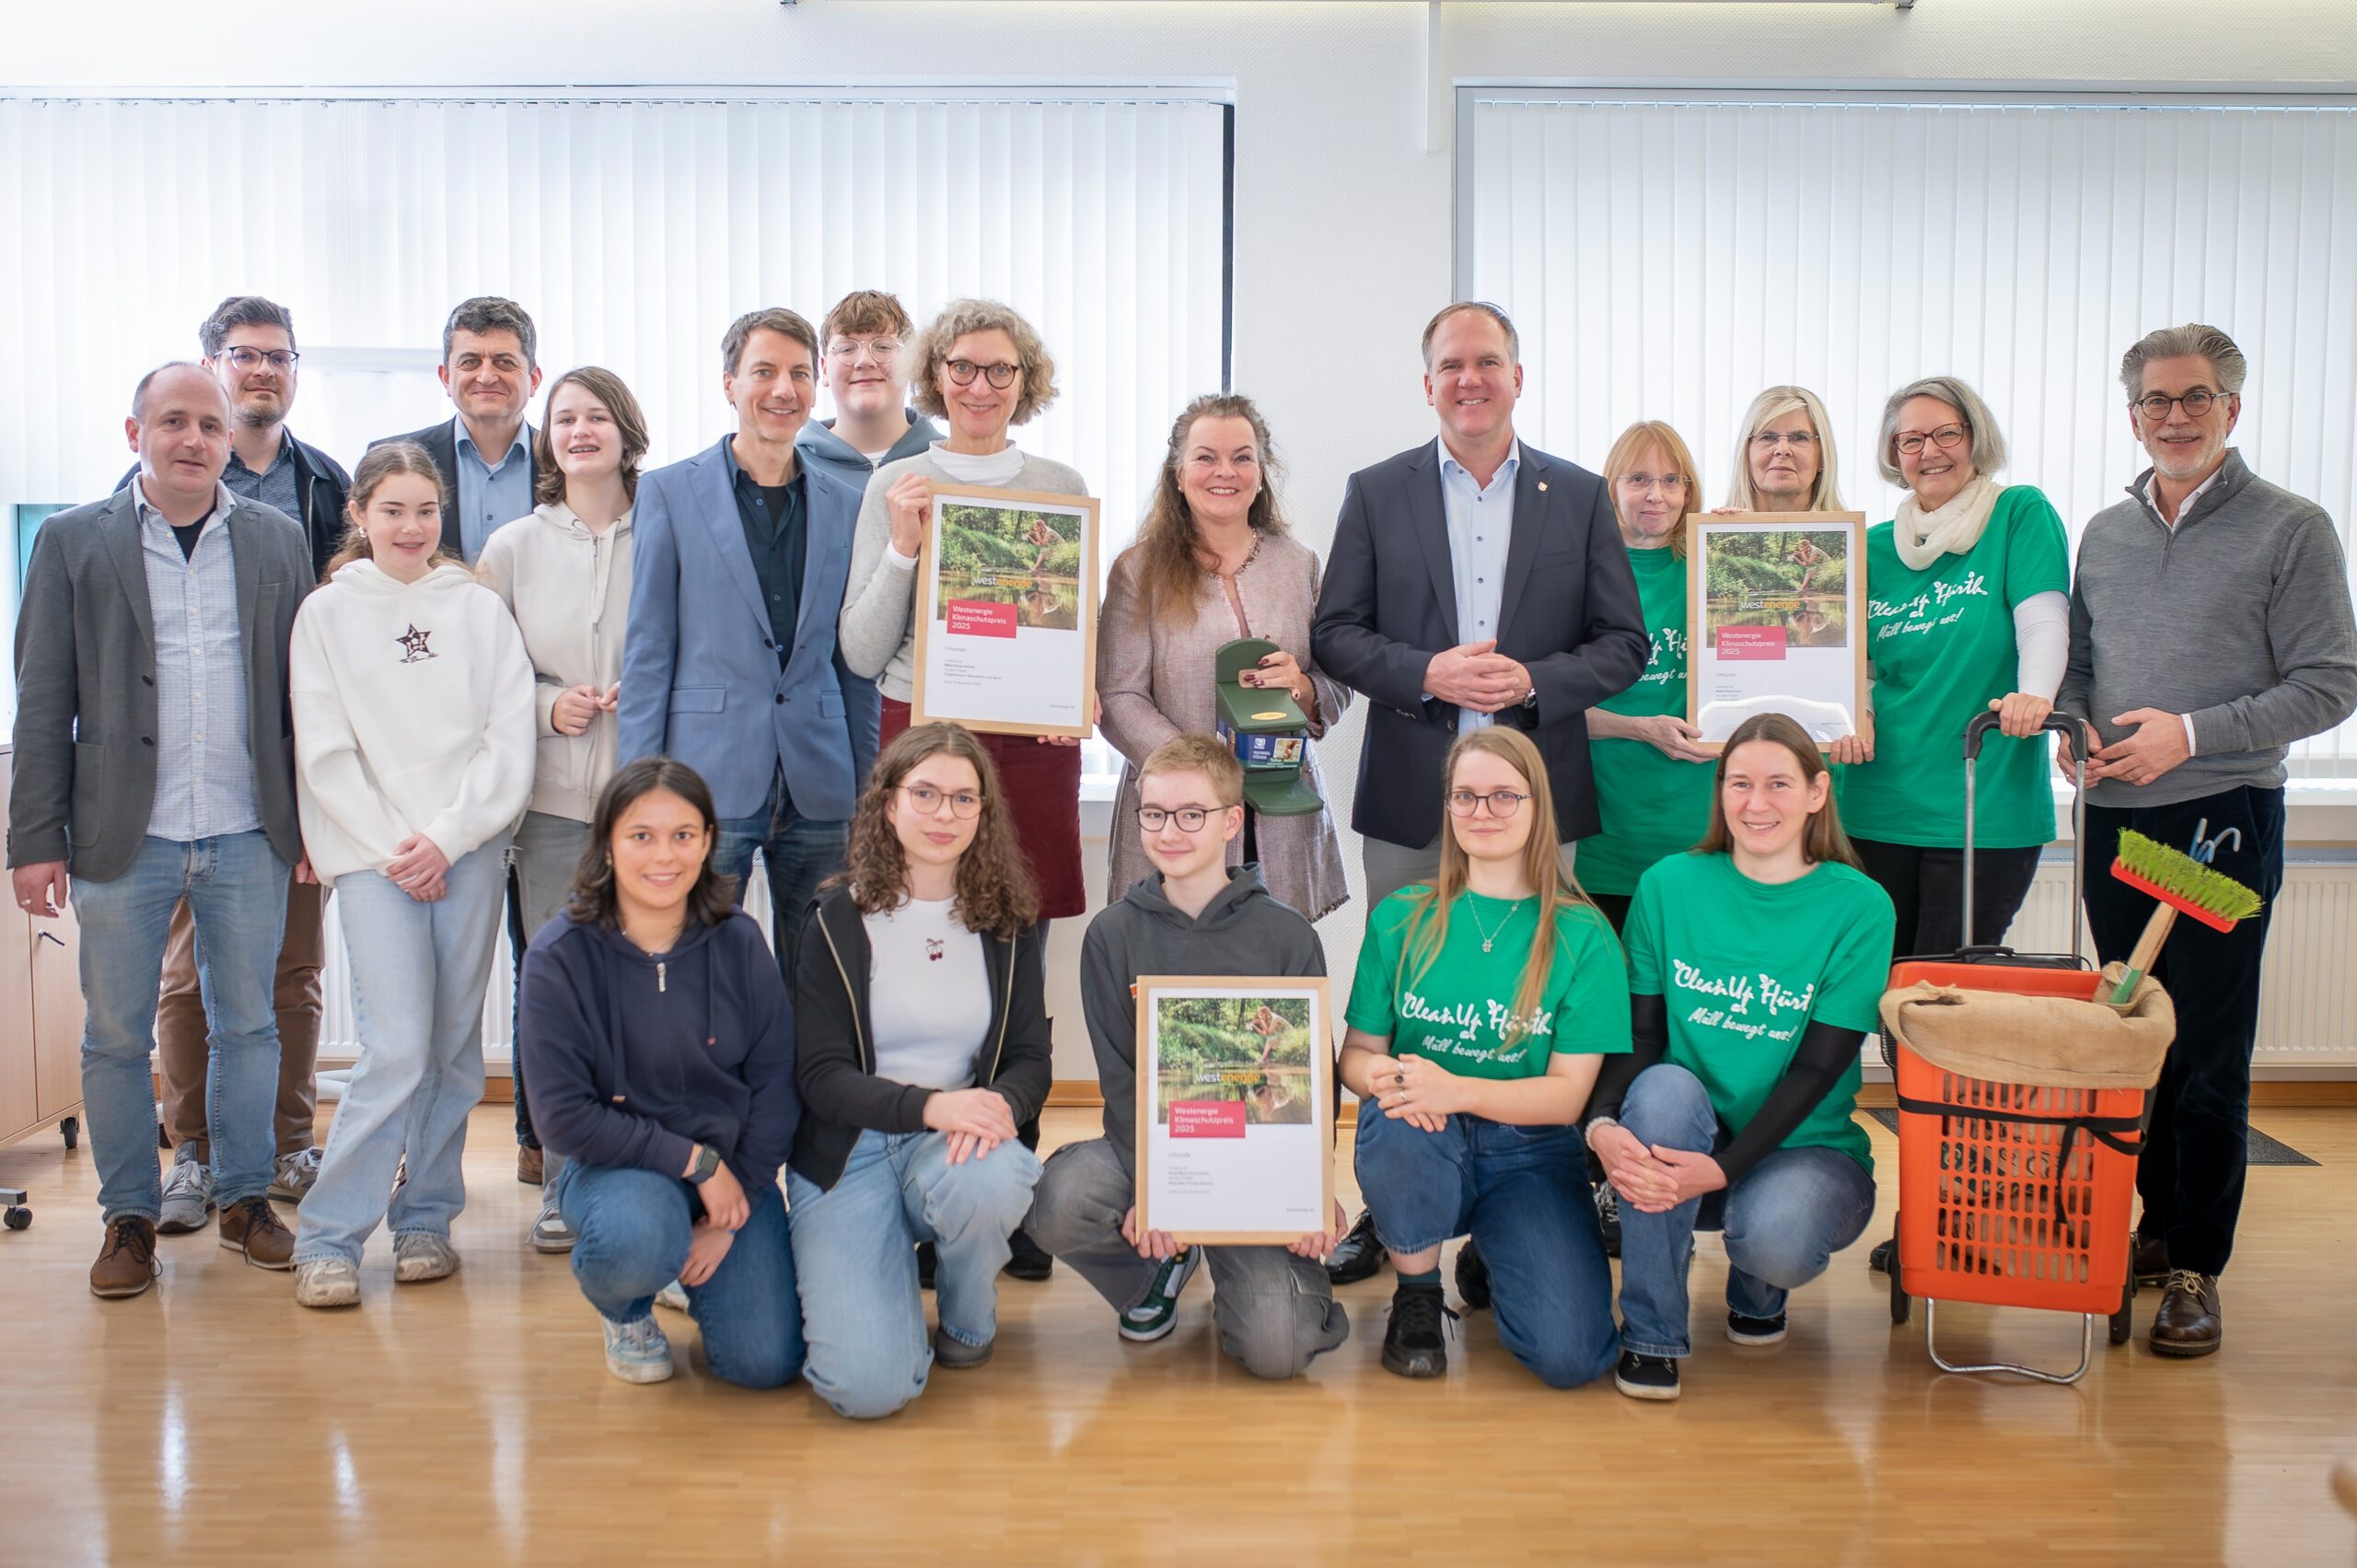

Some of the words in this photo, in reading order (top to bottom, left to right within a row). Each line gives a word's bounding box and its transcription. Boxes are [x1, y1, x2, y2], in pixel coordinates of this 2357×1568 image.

[973, 575, 1033, 588] westenergie
[952, 605, 993, 616] Westenergie
[1740, 599, 1801, 611] westenergie
[952, 614, 1006, 625] Klimaschutzpreis
[1875, 621, 1903, 642] Müll
[1939, 607, 1965, 625] uns!
[952, 621, 970, 630] 2025
[1721, 632, 1762, 641] Westenergie
[1721, 640, 1775, 649] Klimaschutzpreis
[1721, 647, 1740, 656] 2025
[1758, 972, 1815, 1016] Hürt
[1687, 1006, 1724, 1027] Müll
[1722, 1015, 1768, 1040] bewegt
[1422, 1034, 1453, 1054] Müll
[1452, 1040, 1496, 1064] bewegt
[1196, 1072, 1260, 1084] westenergie
[1174, 1107, 1218, 1116] Westenergie
[1174, 1115, 1234, 1125] Klimaschutzpreis
